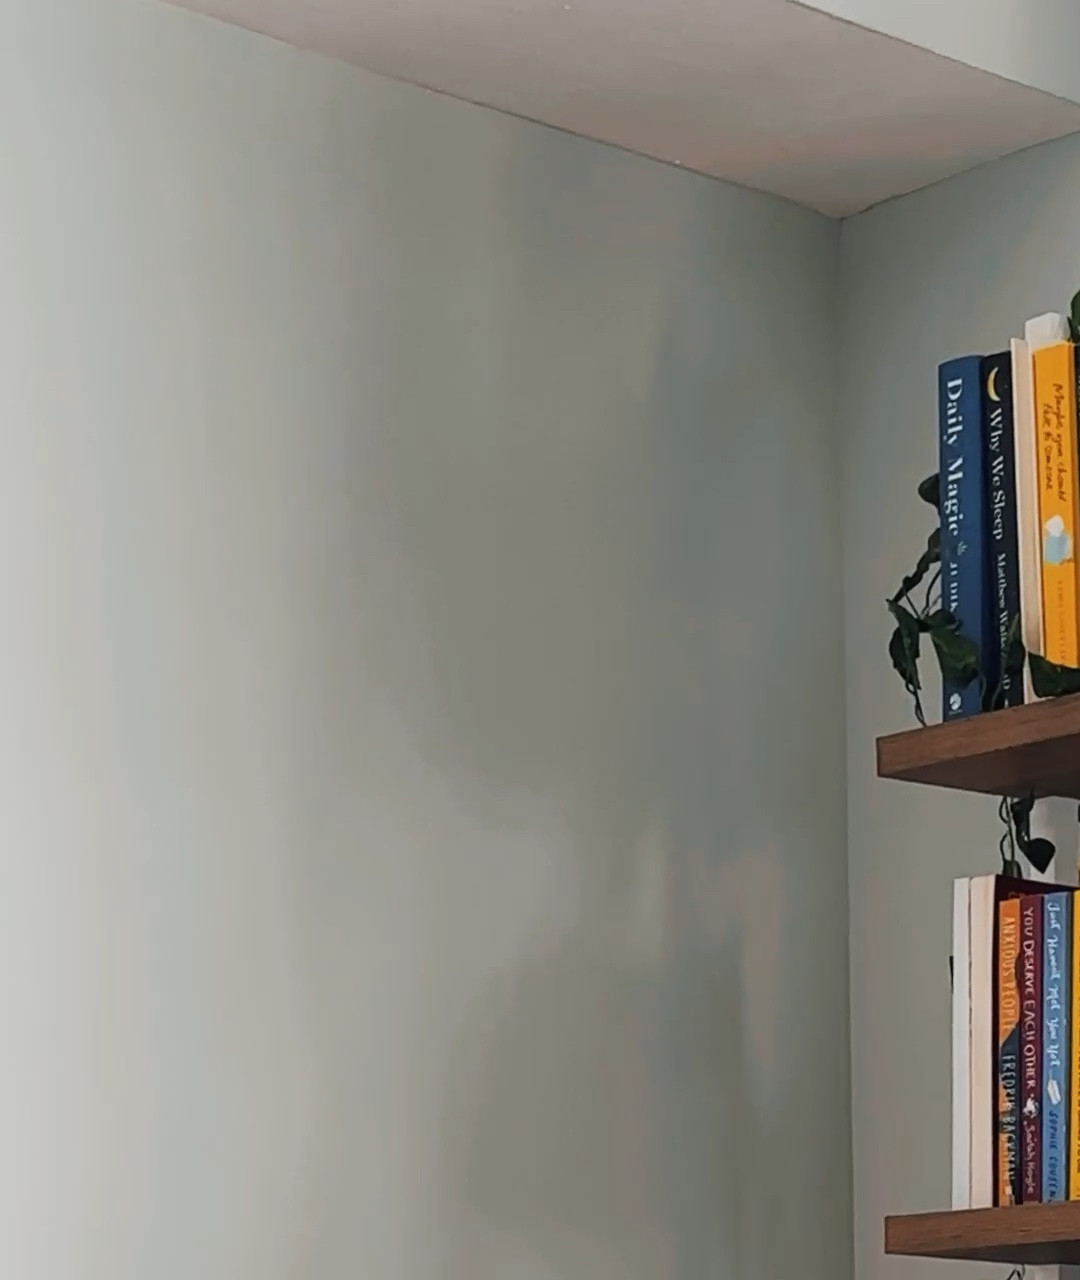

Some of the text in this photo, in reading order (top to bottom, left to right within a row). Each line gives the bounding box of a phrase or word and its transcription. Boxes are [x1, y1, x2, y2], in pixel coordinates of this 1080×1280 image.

[944, 379, 964, 536] Daily Magic
[988, 408, 1005, 540] Why We Sleep
[1003, 917, 1019, 1030] ANXIOUS PEOPLE
[1023, 908, 1036, 1088] YOU DESERVE EACH OTHER
[1003, 1055, 1016, 1180] FREDRIK BACKMAN
